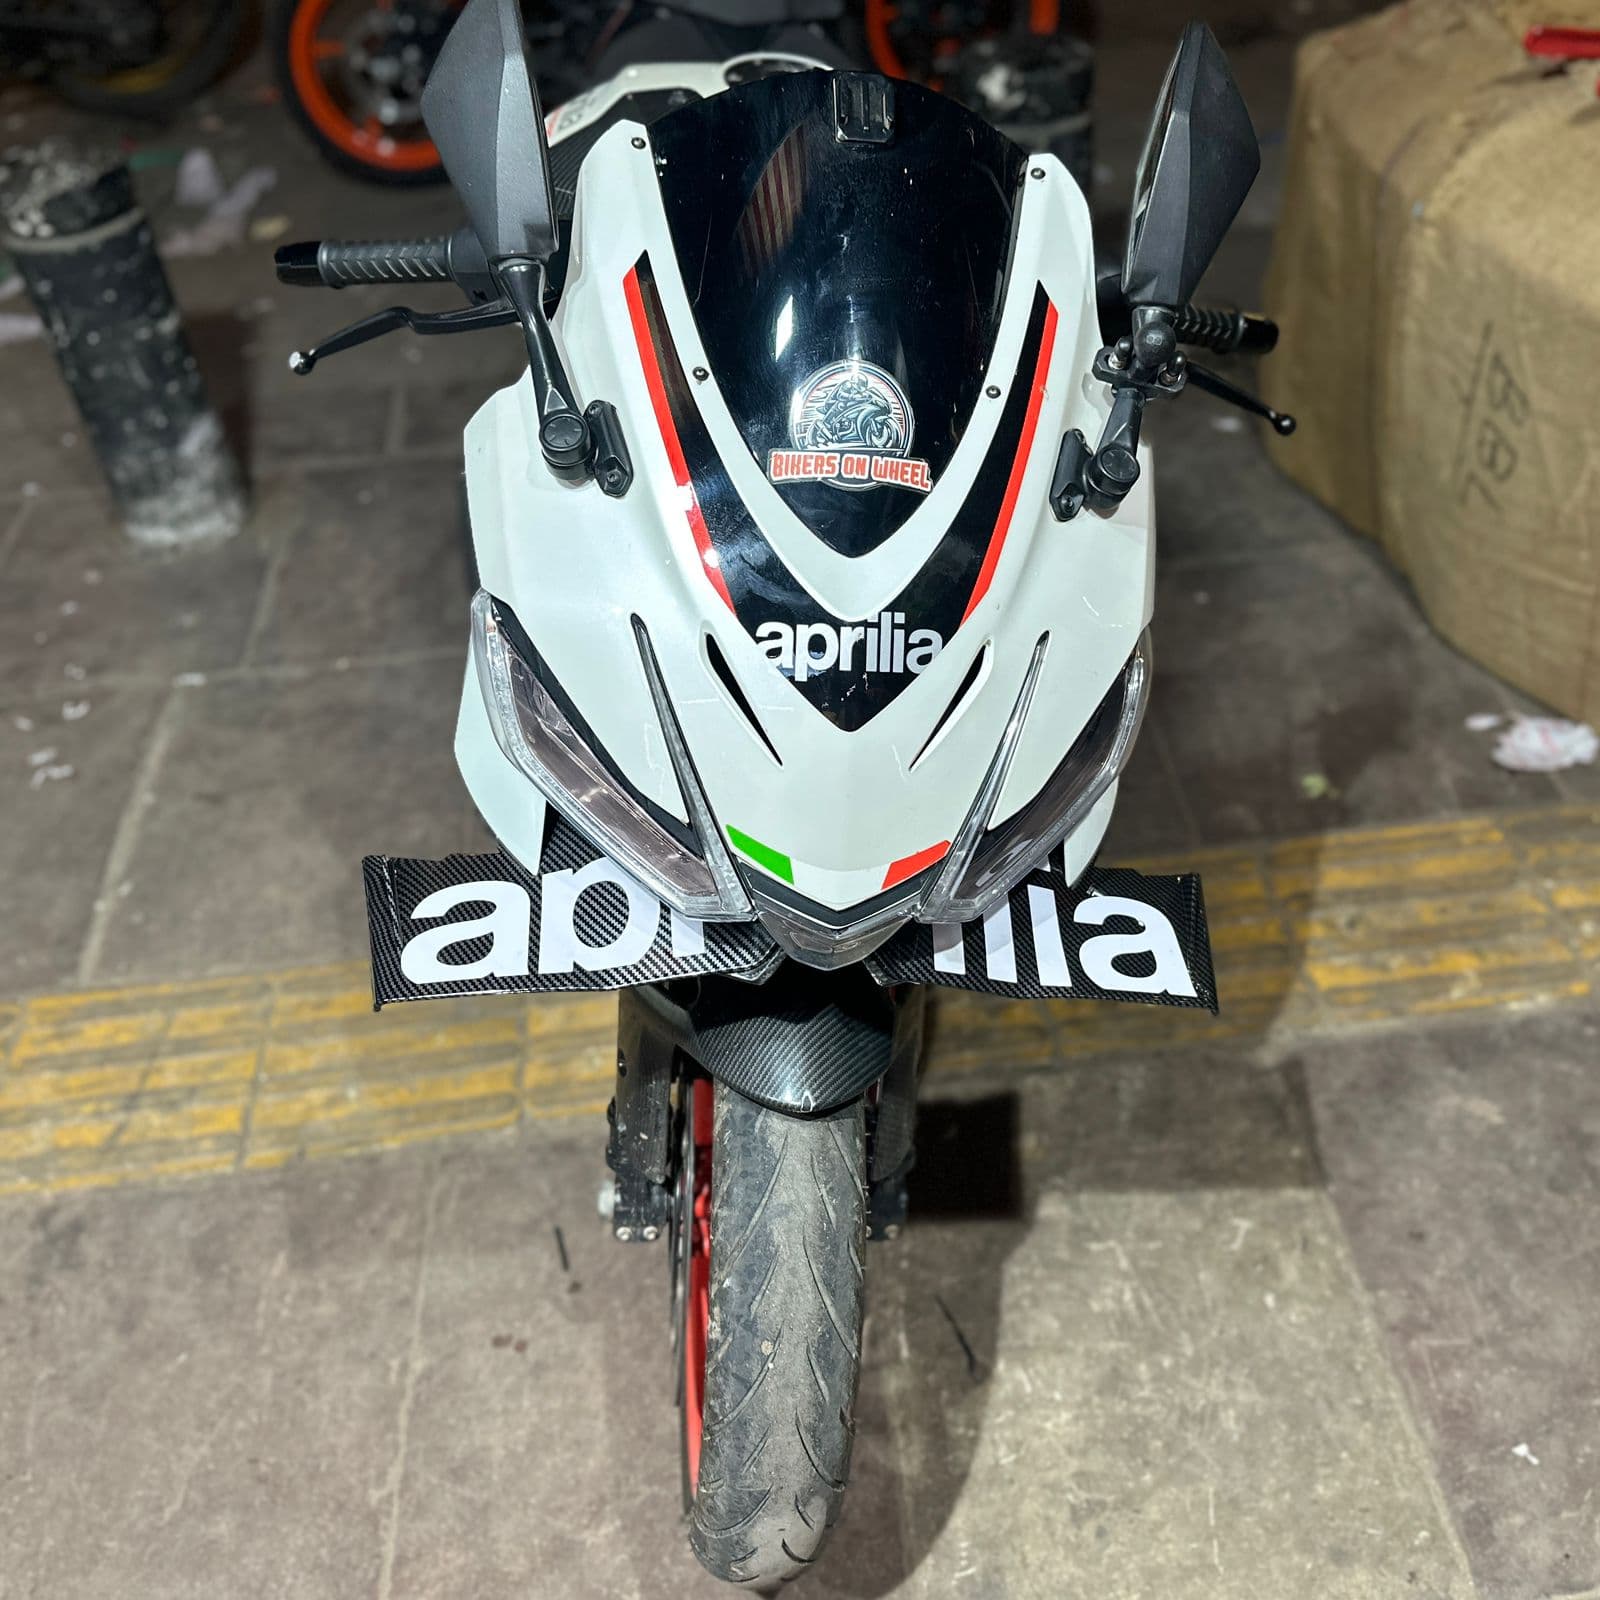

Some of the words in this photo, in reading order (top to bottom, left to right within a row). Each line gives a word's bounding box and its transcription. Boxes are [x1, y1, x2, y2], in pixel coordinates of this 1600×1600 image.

[771, 452, 838, 478] BIKERS
[842, 455, 868, 477] ON
[872, 457, 930, 489] WHEEL
[755, 611, 943, 682] aprilia
